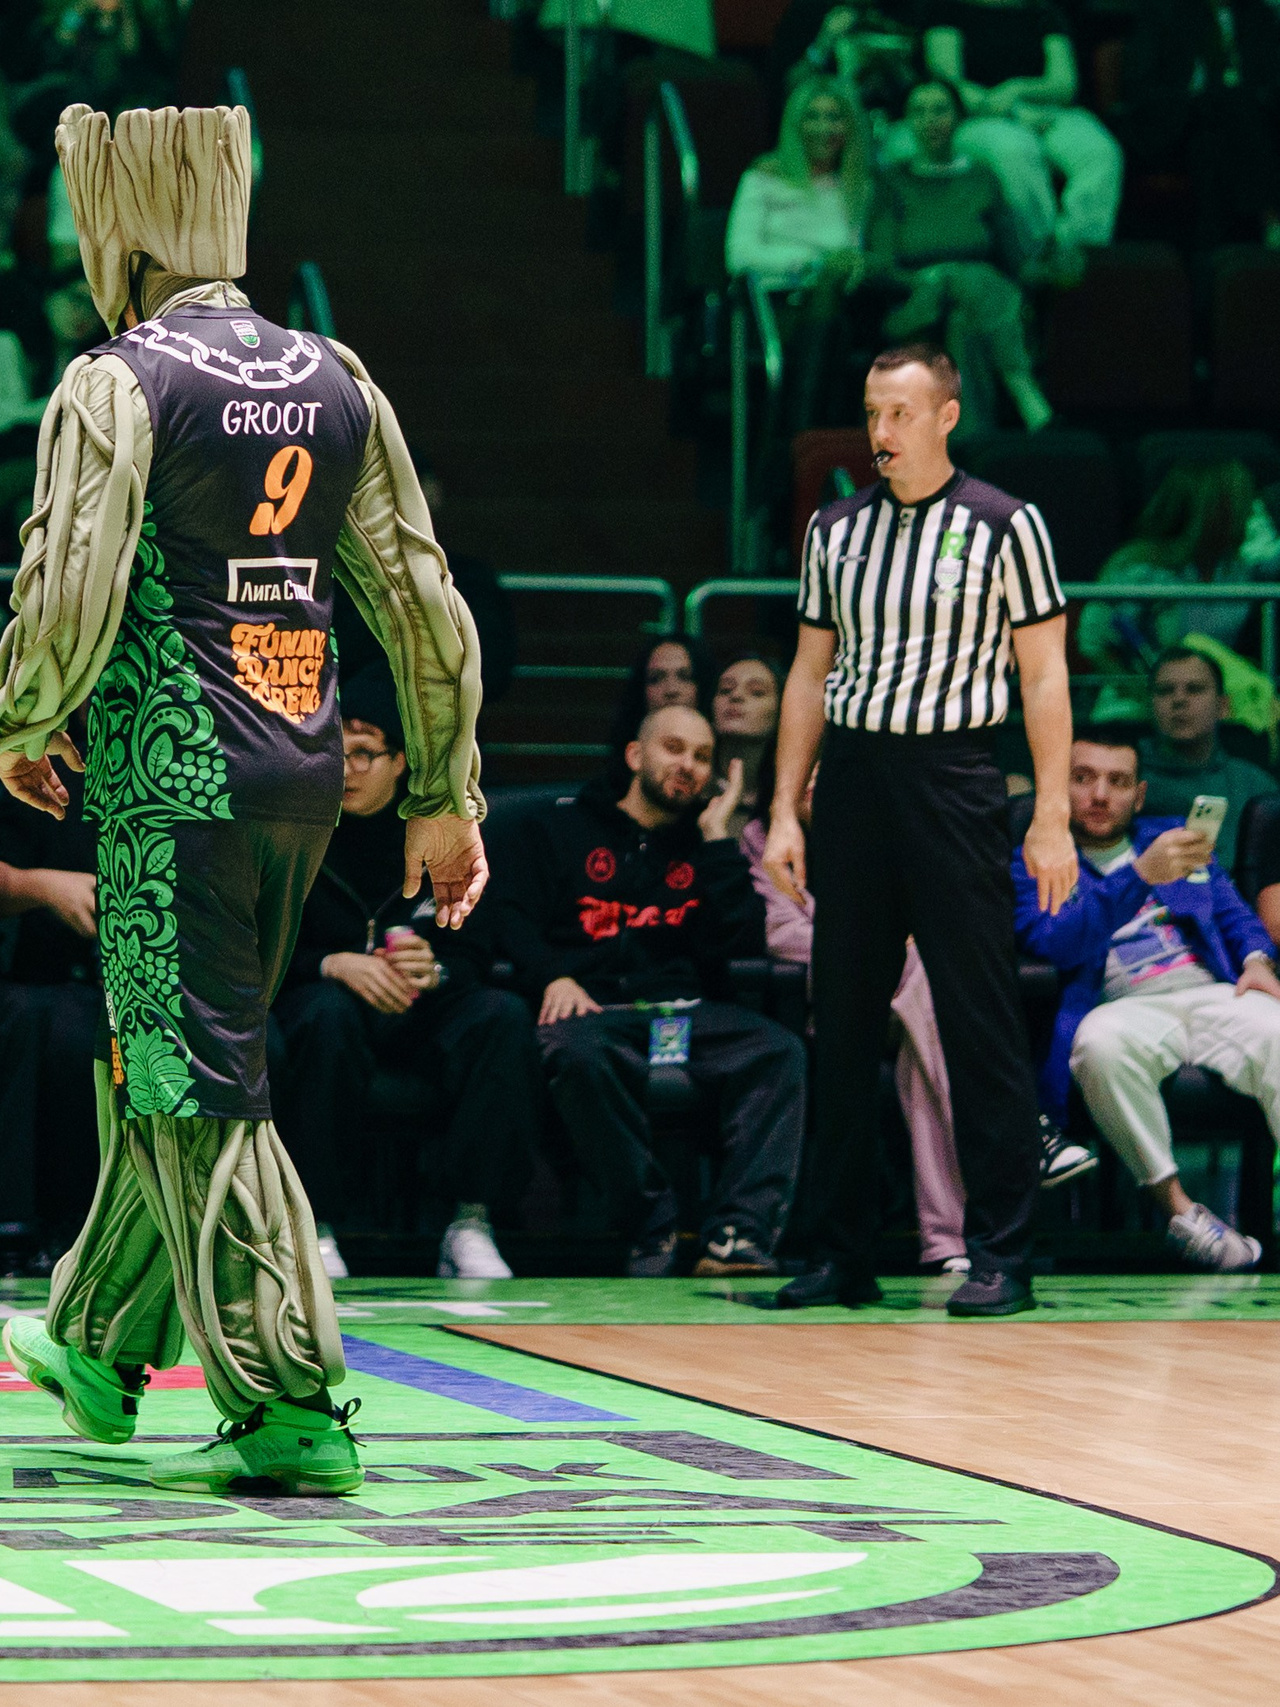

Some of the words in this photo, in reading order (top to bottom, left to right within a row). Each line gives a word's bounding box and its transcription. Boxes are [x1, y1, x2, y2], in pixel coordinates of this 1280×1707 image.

[222, 400, 322, 436] GROOT
[249, 445, 313, 536] 9
[231, 622, 326, 662] FUNNY
